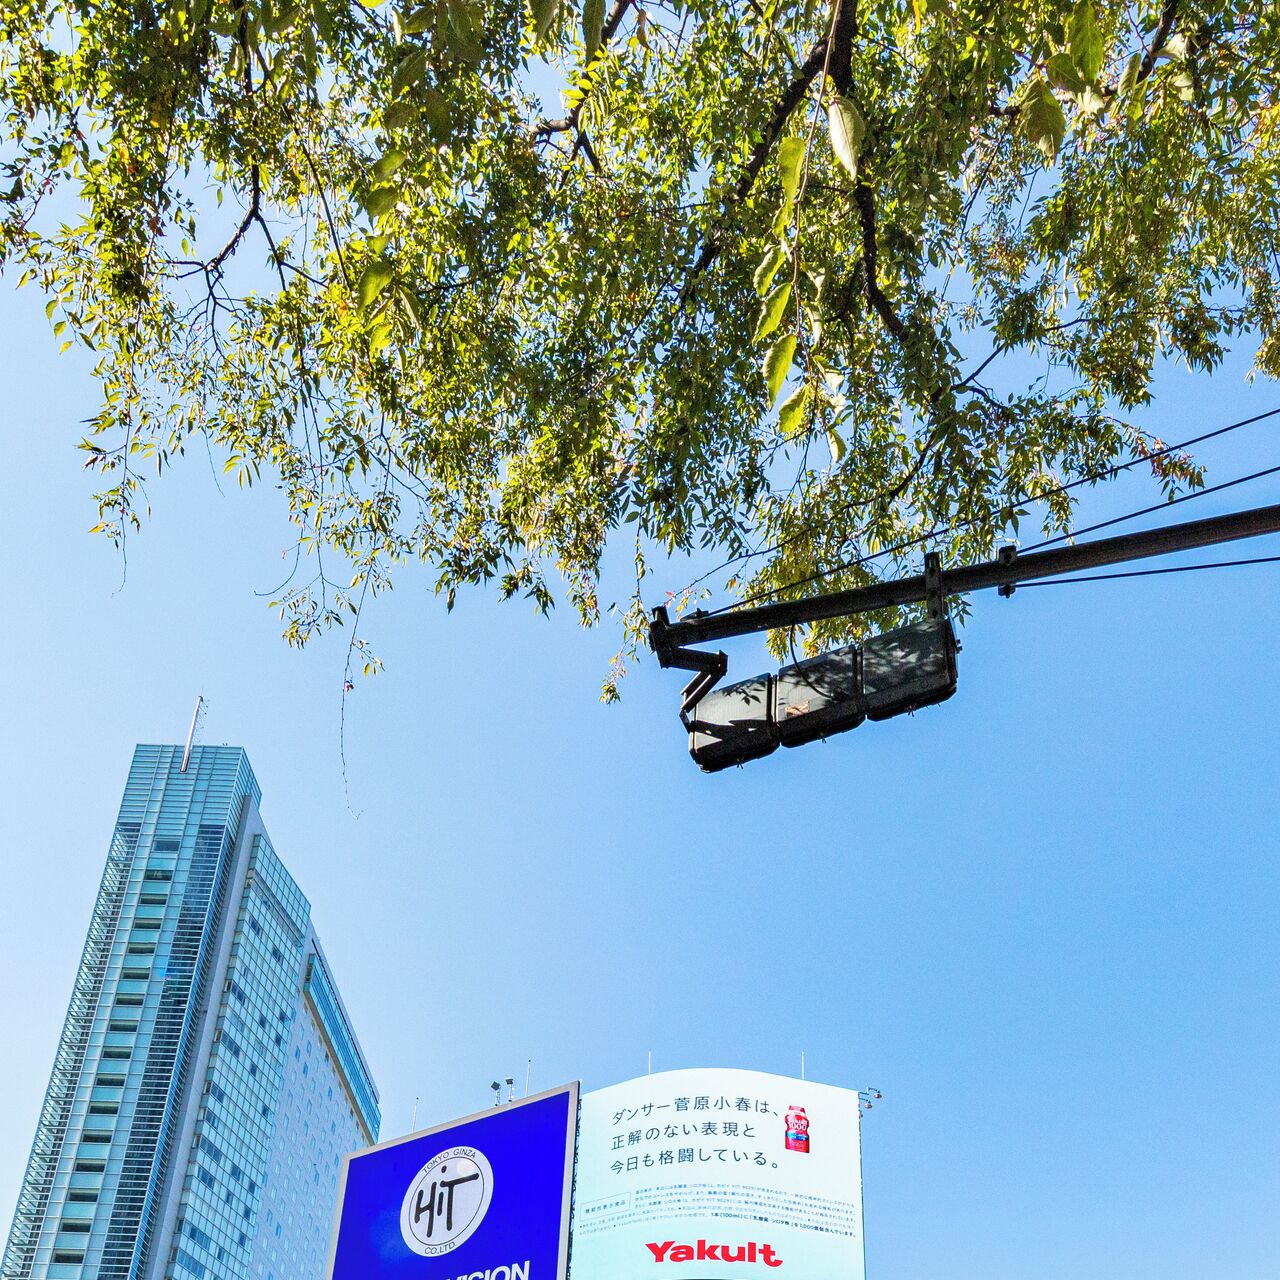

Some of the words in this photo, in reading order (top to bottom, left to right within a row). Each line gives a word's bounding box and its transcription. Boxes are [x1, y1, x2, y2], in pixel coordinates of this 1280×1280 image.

[611, 1095, 779, 1126] ダンサー菅原小春は、
[610, 1120, 757, 1151] 正解のない表現と
[421, 1151, 450, 1174] TOKYO
[453, 1148, 477, 1160] GINZA
[609, 1147, 780, 1175] 今日も格闘している。
[644, 1239, 784, 1268] Yakult
